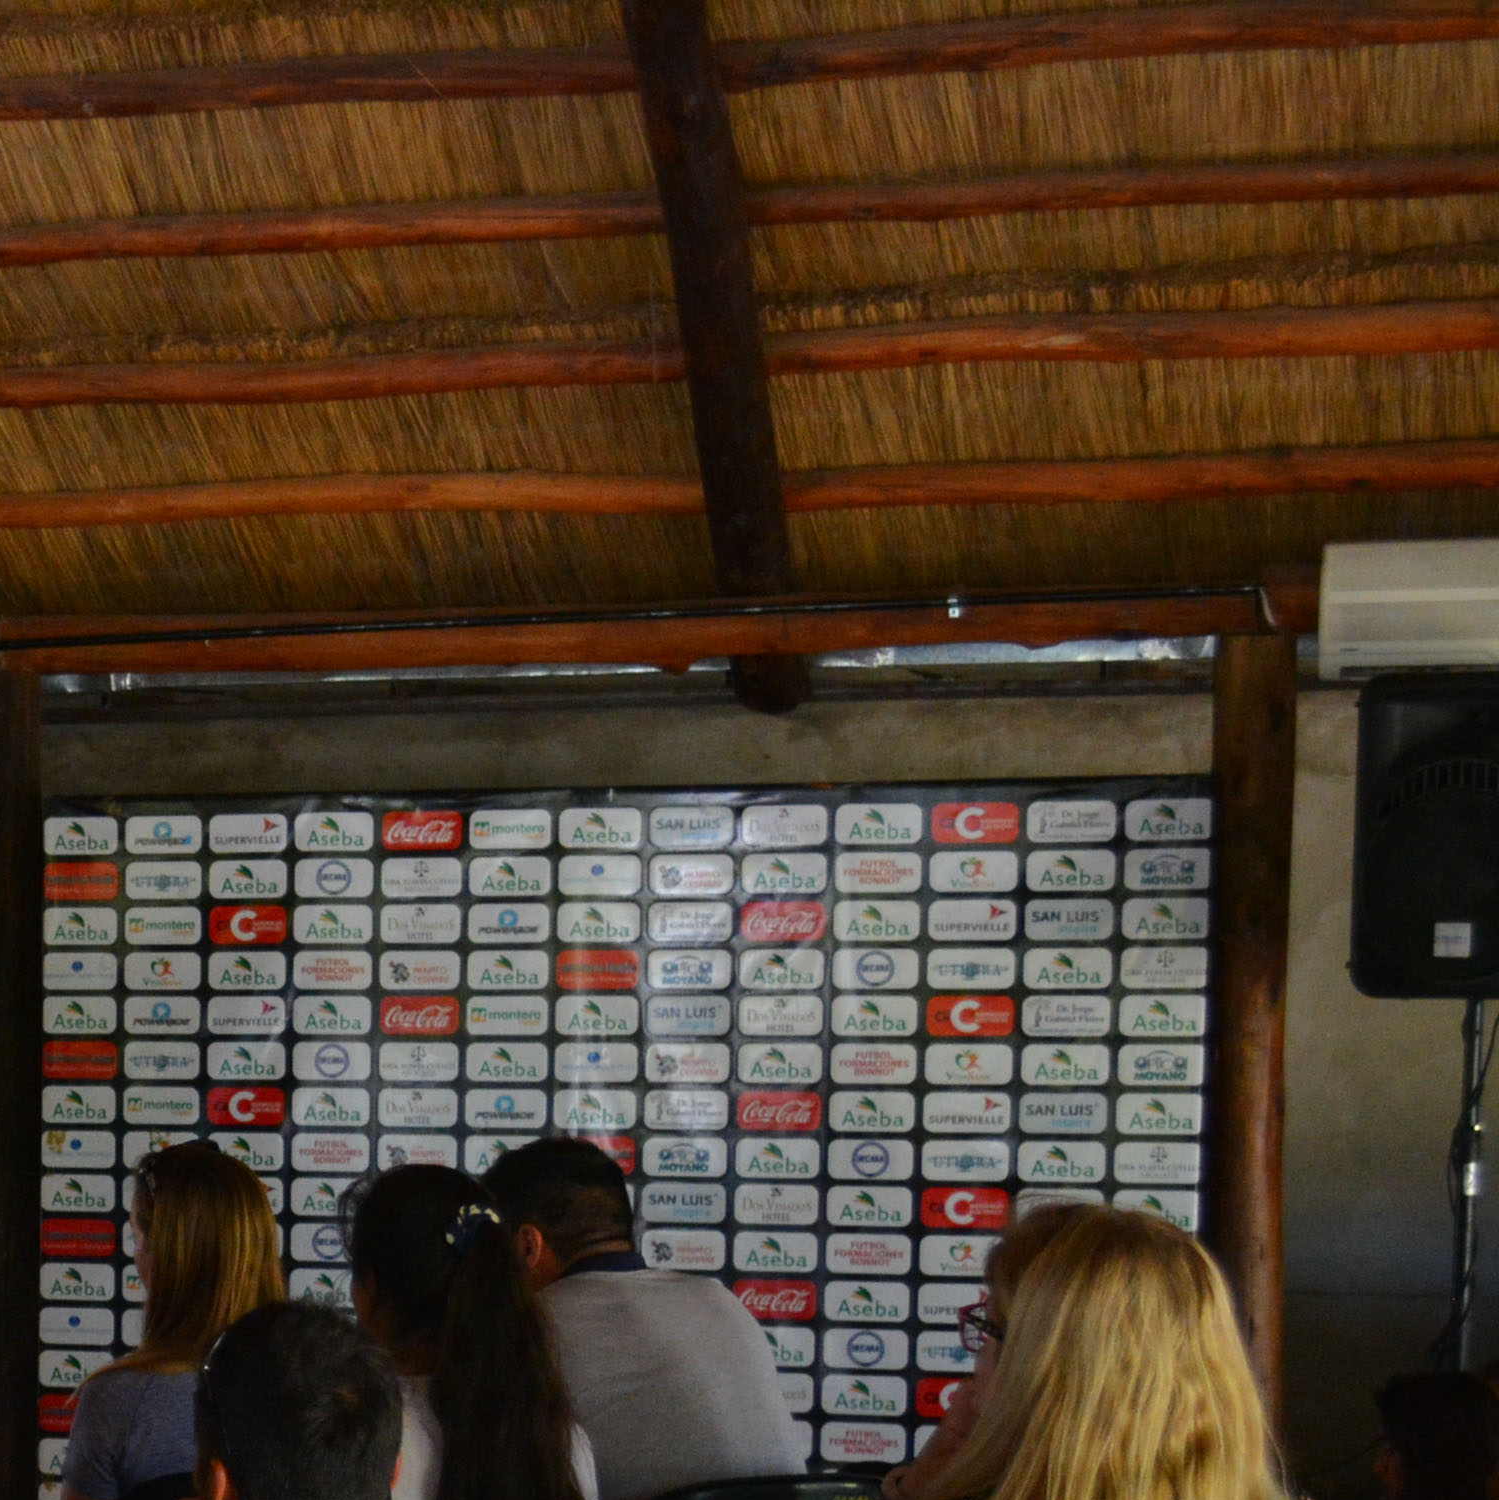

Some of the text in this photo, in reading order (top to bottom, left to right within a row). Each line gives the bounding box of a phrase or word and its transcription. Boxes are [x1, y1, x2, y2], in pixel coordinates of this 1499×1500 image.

[492, 823, 545, 833] montero
[656, 817, 721, 829] SAN LUIS
[1140, 819, 1203, 835] Aseba
[308, 831, 364, 846] Aseba
[573, 827, 631, 842] Aseba
[850, 823, 911, 840] Aseba
[55, 835, 109, 850] Aseba
[215, 836, 281, 845] SUPERVIELLE
[844, 868, 914, 877] FORMACIONES
[1041, 870, 1104, 887] Aseba
[1140, 875, 1194, 885] MOYANO
[221, 879, 277, 894] Aseba
[483, 876, 541, 891] Aseba
[755, 873, 816, 888] Aseba
[1031, 911, 1099, 922] SAN LUIS
[55, 925, 108, 941] Aseba
[146, 921, 195, 931] montero
[306, 923, 363, 939] Aseba
[570, 922, 630, 937] Aseba
[847, 920, 909, 937] Aseba
[935, 923, 1009, 933] SUPERVIELLE
[1136, 918, 1200, 935] Aseba
[221, 968, 277, 986] Aseba
[480, 969, 538, 984] Aseba
[663, 976, 712, 984] MOYANO
[754, 968, 814, 984] Aseba
[1038, 967, 1101, 984] Aseba
[489, 1011, 541, 1019] montero
[653, 1007, 716, 1018] SAN LUIS
[54, 1015, 108, 1029] Aseba
[213, 1017, 279, 1026] SUPERVIELLE
[305, 1014, 361, 1030] Aseba
[569, 1014, 627, 1030] Aseba
[845, 1014, 906, 1031] Aseba
[1133, 1014, 1196, 1032] Aseba
[220, 1060, 276, 1076] Aseba
[479, 1061, 537, 1077] Aseba
[751, 1063, 811, 1078] Aseba
[839, 1060, 909, 1068] FORMACIONES
[1035, 1063, 1098, 1080] Aseba
[1134, 1071, 1187, 1080] MOYANO
[53, 1105, 107, 1119] Aseba
[144, 1101, 193, 1110] montero
[1026, 1104, 1093, 1116] SAN LUIS
[304, 1106, 360, 1122] Aseba
[567, 1109, 626, 1124] Aseba
[842, 1110, 903, 1127] Aseba
[930, 1115, 1003, 1125] SUPERVIELLE
[1129, 1112, 1193, 1130] Aseba
[236, 1150, 275, 1167] eba
[749, 1158, 809, 1173] Aseba
[659, 1163, 709, 1172] MOYANO
[1031, 1161, 1094, 1177] Aseba
[52, 1191, 107, 1208] Aseba
[649, 1194, 713, 1205] SAN LUIS
[762, 1212, 791, 1222] HOTEL
[840, 1205, 901, 1222] Aseba
[747, 1251, 807, 1268] Aseba
[834, 1250, 903, 1258] FORMACIONES
[51, 1281, 106, 1296] Aseba
[838, 1300, 898, 1316] Aseba
[835, 1394, 896, 1411] Aseba
[829, 1439, 899, 1447] FORMACIONES
